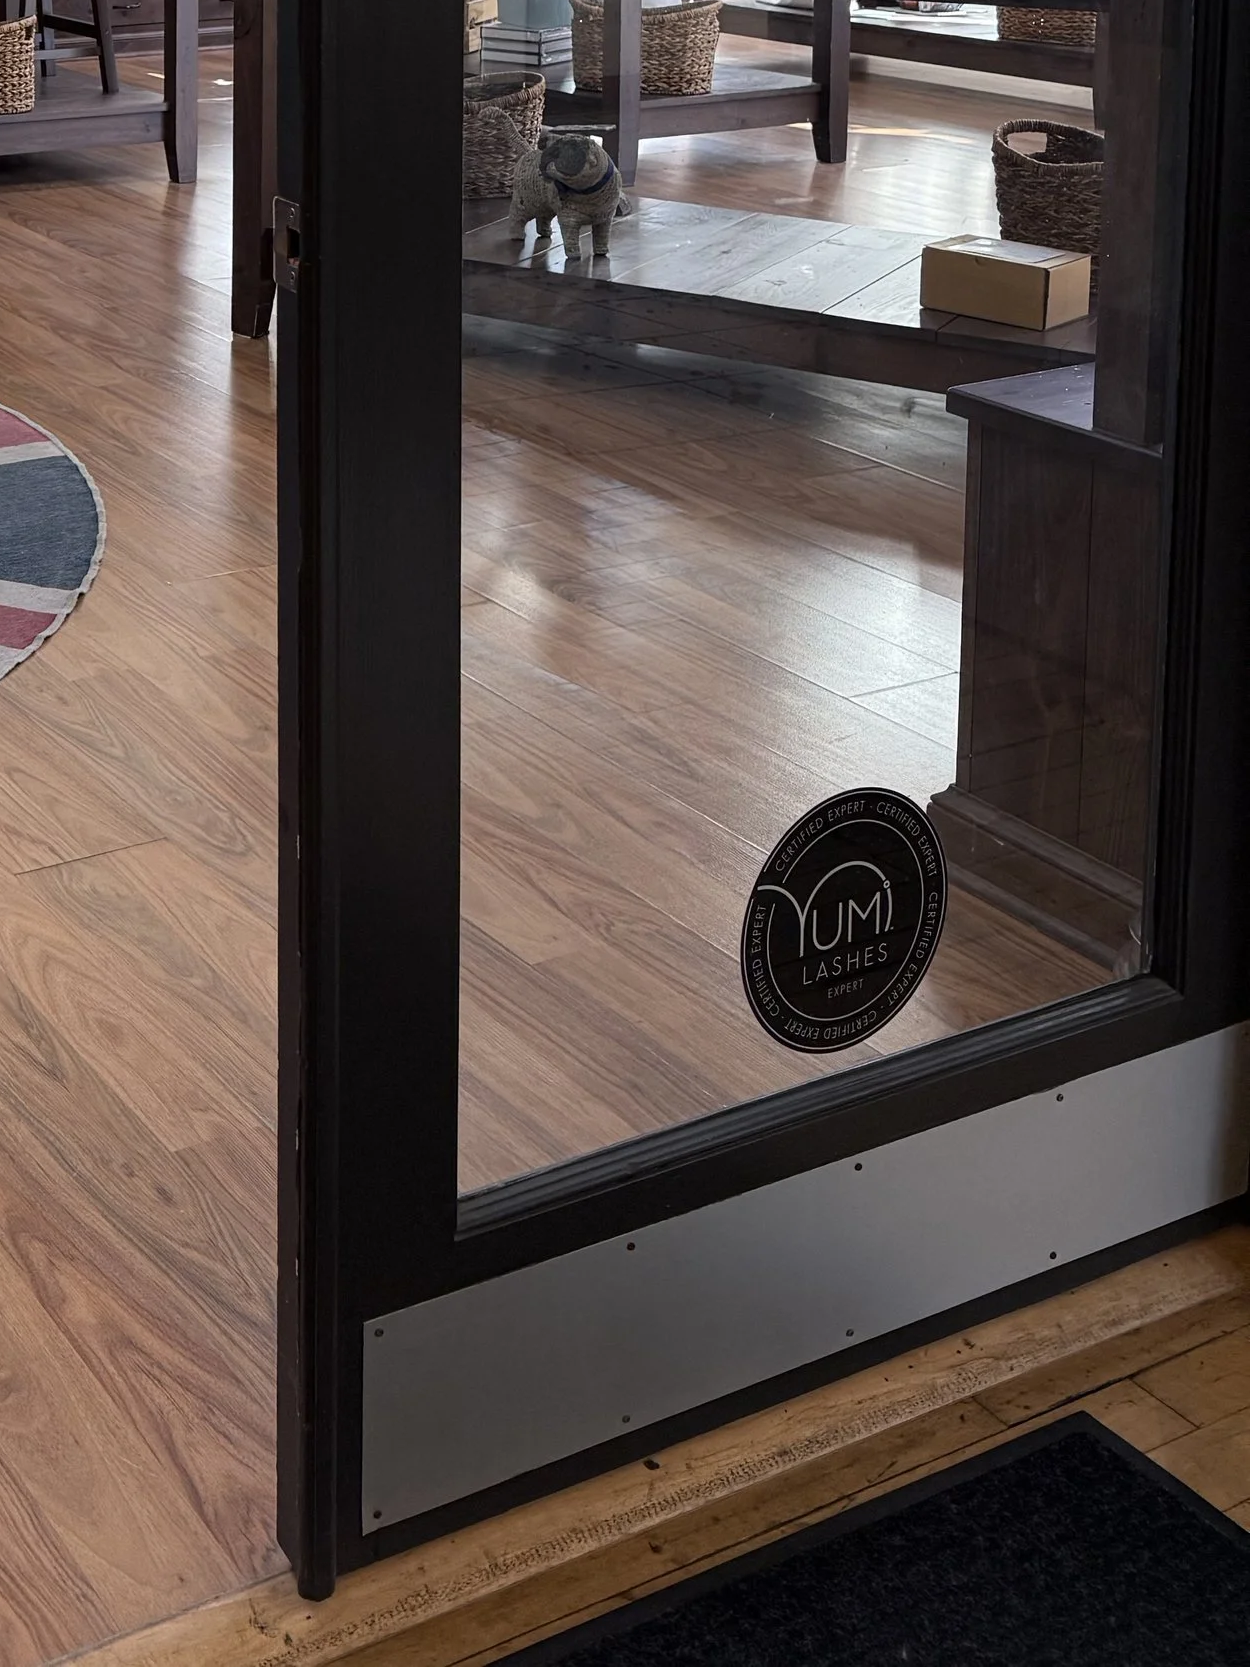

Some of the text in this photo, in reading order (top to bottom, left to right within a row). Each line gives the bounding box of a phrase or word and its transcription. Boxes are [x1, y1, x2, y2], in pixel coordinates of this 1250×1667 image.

[828, 800, 865, 822] EXPERT
[876, 801, 920, 837] CERTIFIED
[776, 817, 824, 872] CERTIFIED
[918, 832, 938, 877] EXPERT
[751, 905, 767, 954] EXPERT
[916, 892, 938, 959] CERTIFIED
[803, 942, 889, 986] LASHES
[888, 963, 918, 1007] EXPERT
[752, 957, 780, 1016] CERTIFIED
[827, 978, 865, 999] EXPERT
[784, 1017, 819, 1040] EXPERT
[824, 1010, 877, 1040] CERTIFIED
